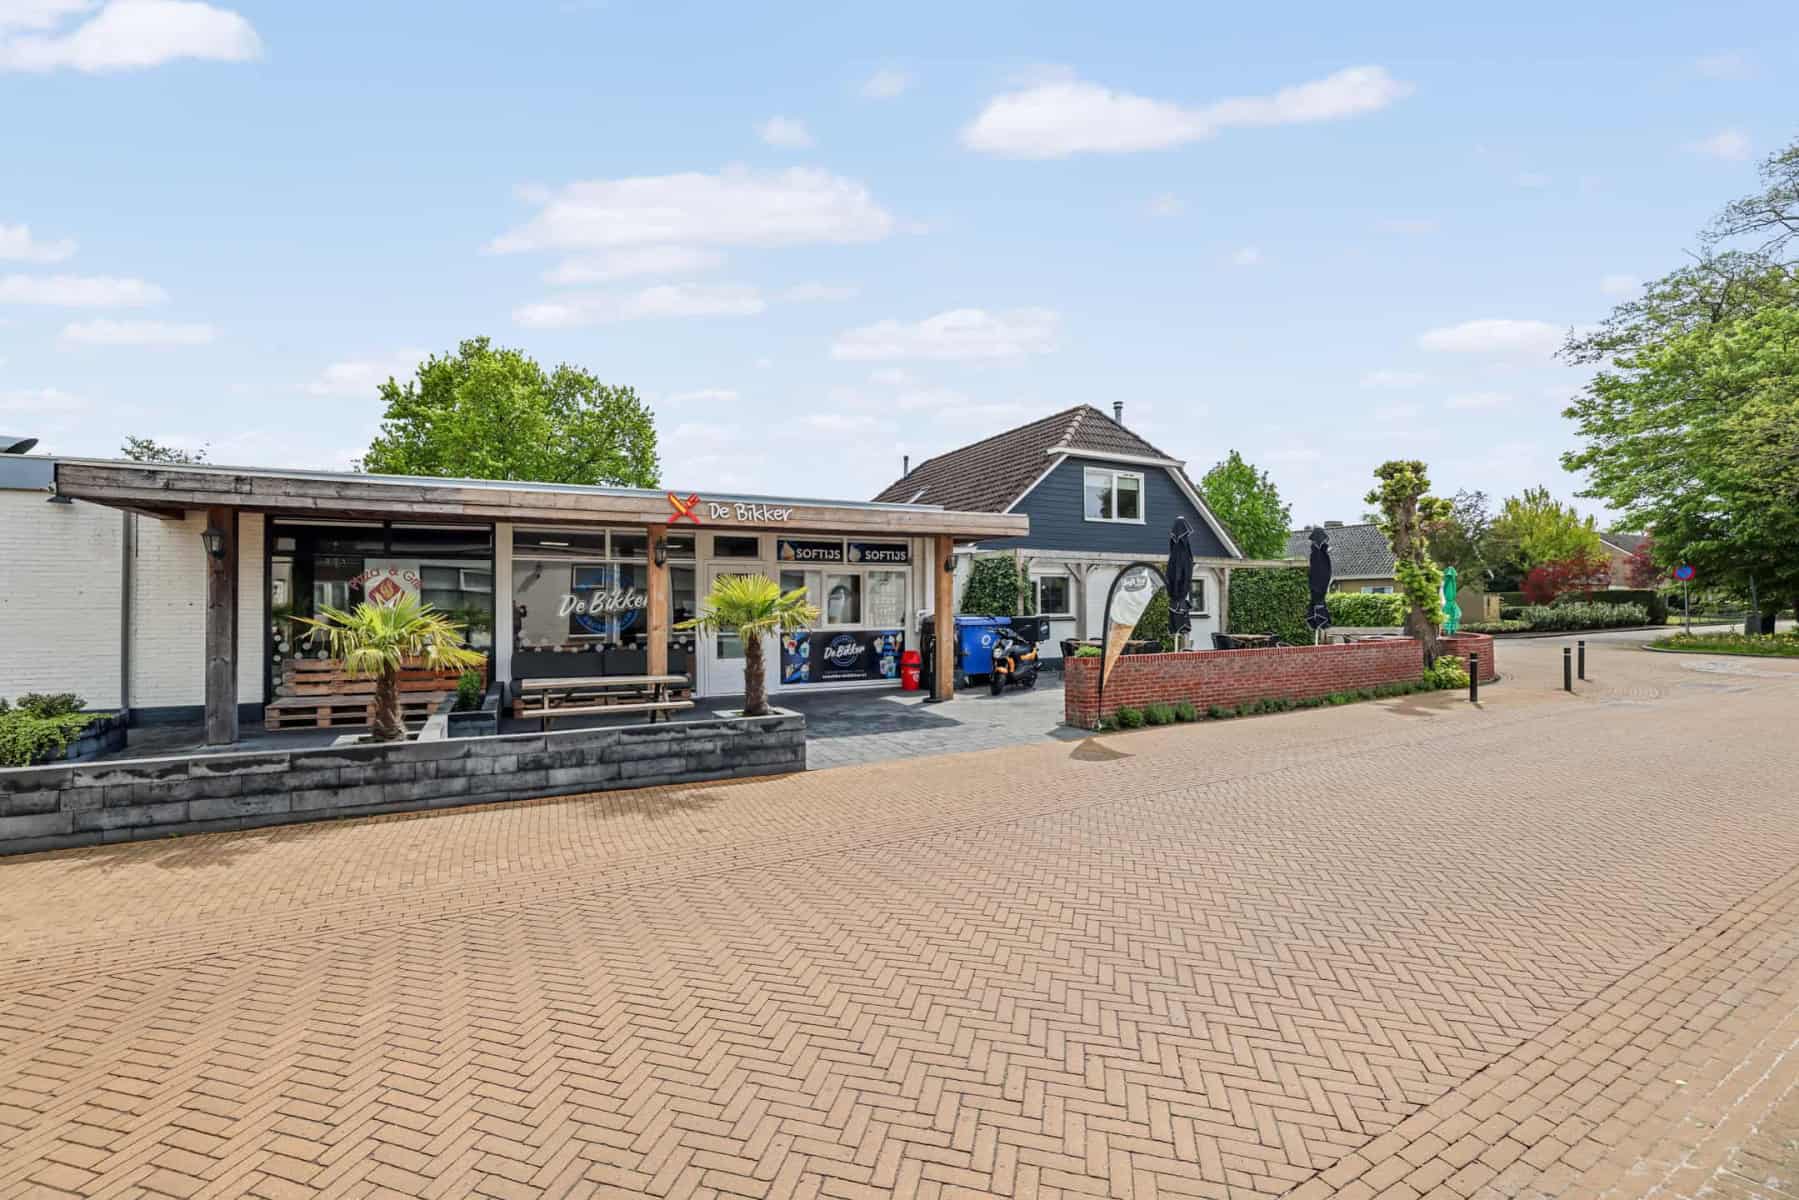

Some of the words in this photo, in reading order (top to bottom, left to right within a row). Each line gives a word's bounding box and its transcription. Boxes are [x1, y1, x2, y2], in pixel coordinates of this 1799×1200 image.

[708, 502, 730, 519] De
[735, 503, 793, 522] Bikker
[796, 548, 841, 560] SOFTIJS
[865, 550, 907, 561] SOFTIJS
[558, 594, 585, 616] De
[823, 646, 837, 660] De
